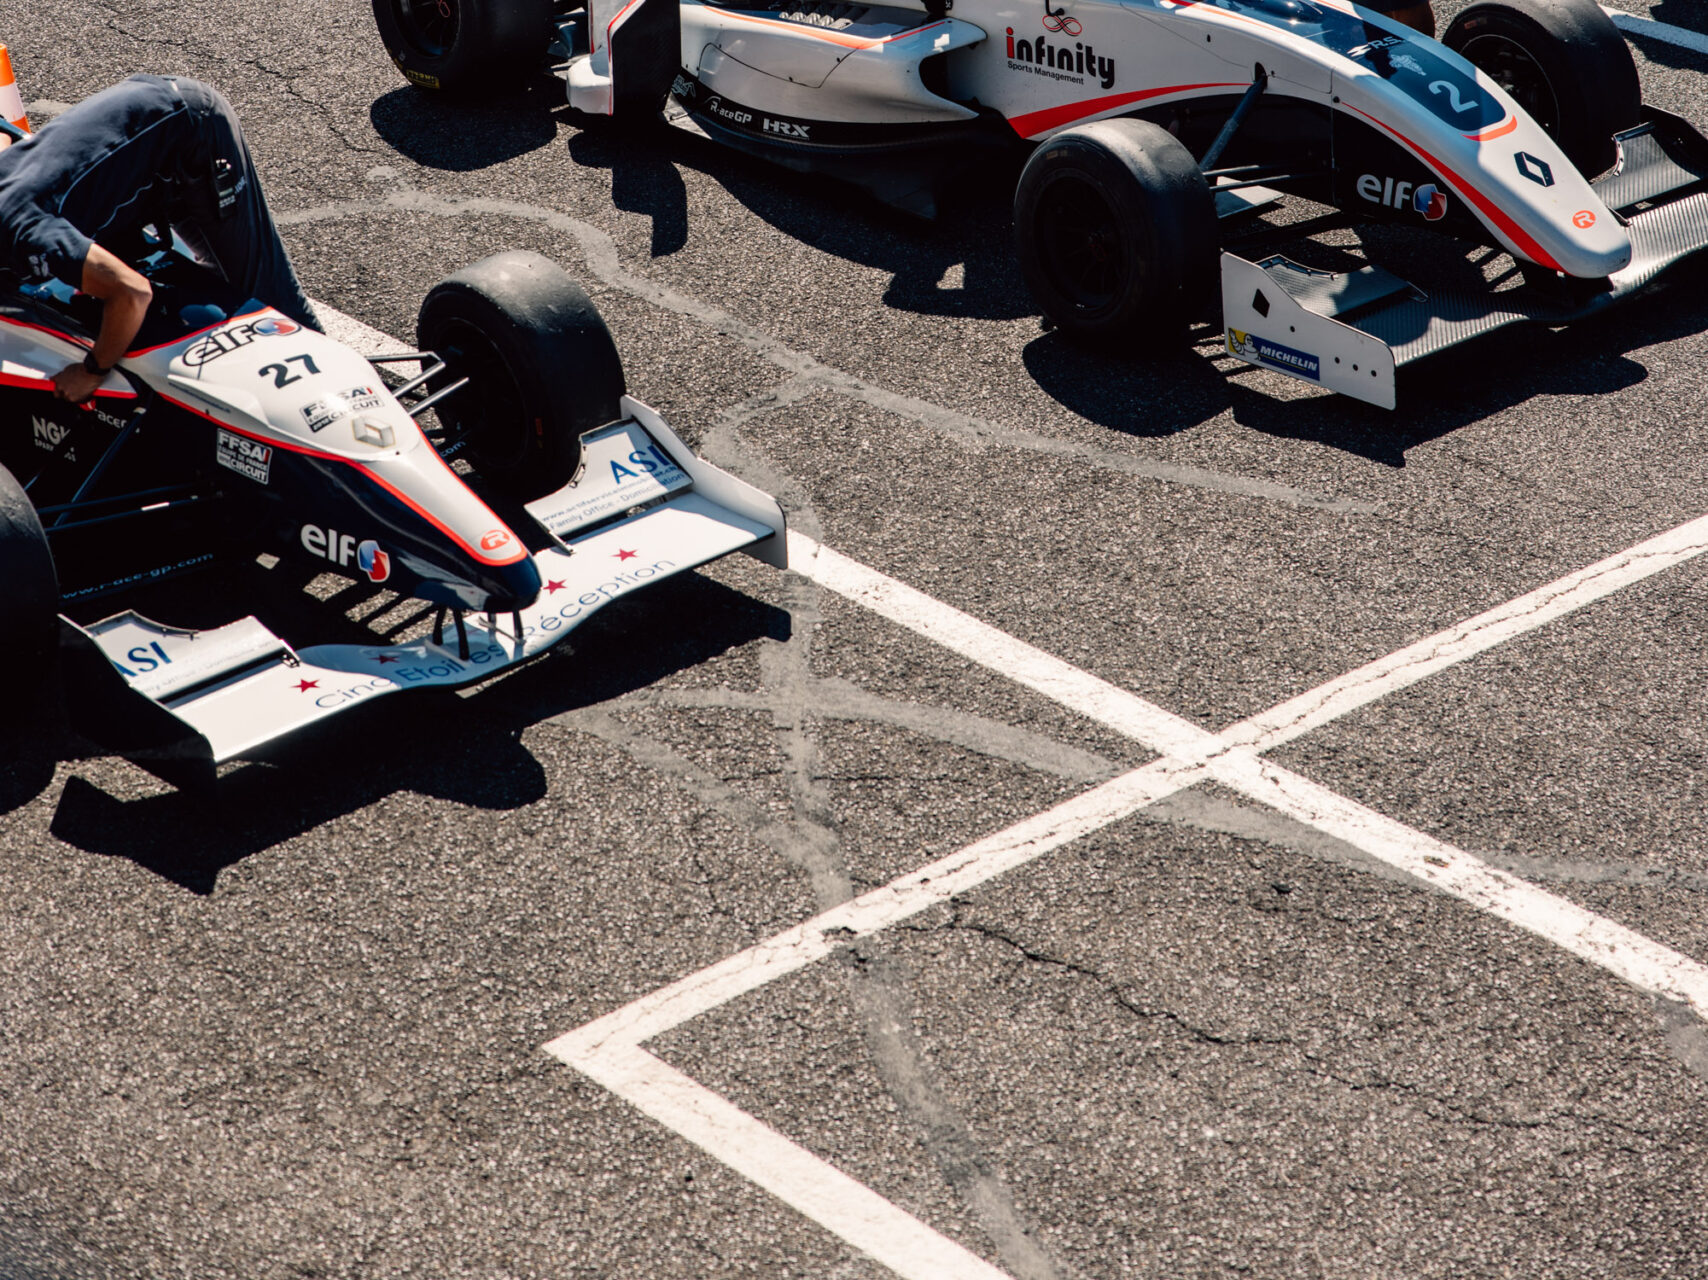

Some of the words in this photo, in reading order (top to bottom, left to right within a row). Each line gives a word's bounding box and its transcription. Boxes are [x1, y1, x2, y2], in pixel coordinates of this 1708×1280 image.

[1006, 26, 1115, 89] infinity
[1007, 60, 1033, 73] Sports
[1034, 66, 1084, 85] Management
[1428, 80, 1479, 114] 2
[763, 118, 811, 138] HRX
[1356, 173, 1412, 209] elf
[182, 323, 258, 366] elf
[1260, 345, 1318, 371] MICHELIN
[258, 353, 321, 389] 27
[218, 431, 265, 463] FFSA
[610, 444, 671, 484] ASI
[230, 458, 266, 481] CIRCUIT
[549, 514, 584, 530] Family
[583, 501, 615, 516] Office
[300, 523, 356, 567] elf
